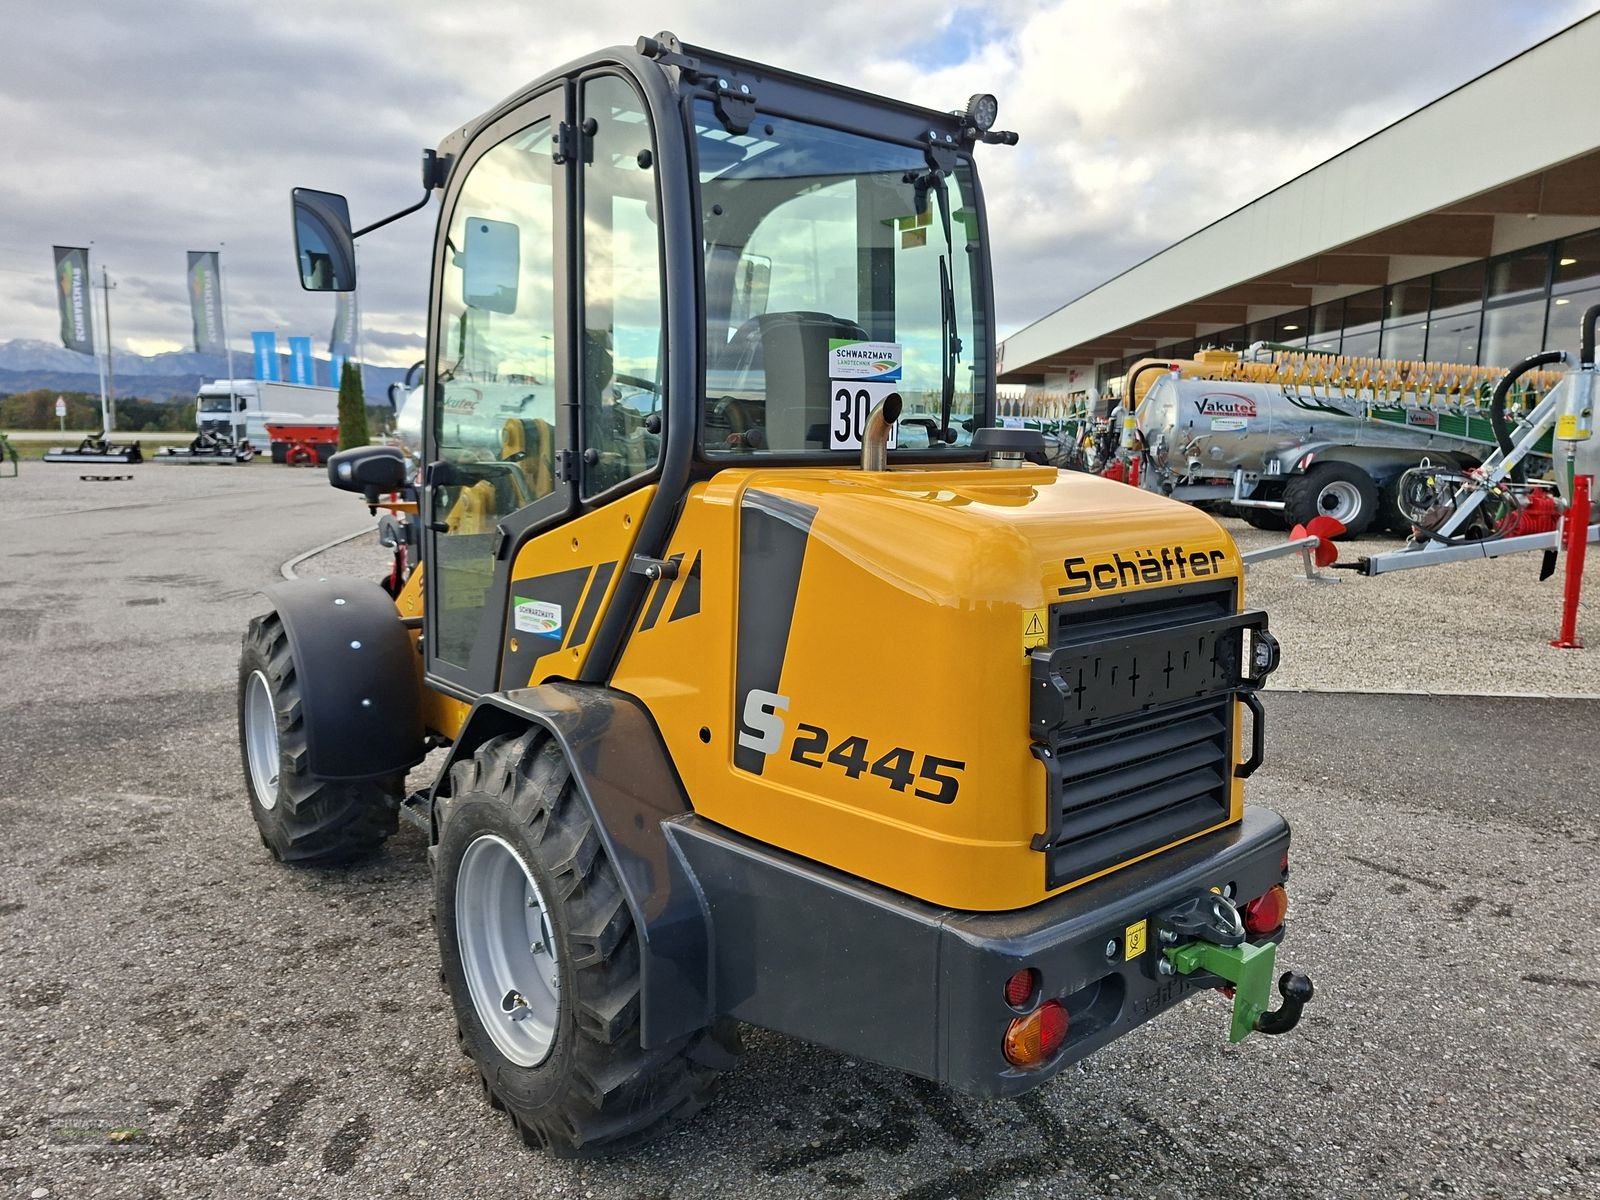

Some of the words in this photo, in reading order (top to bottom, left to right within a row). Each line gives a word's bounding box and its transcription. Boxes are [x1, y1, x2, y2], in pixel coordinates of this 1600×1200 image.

[836, 349, 893, 360] SCHWARZMAYR
[1194, 398, 1257, 415] Vakutec
[1057, 546, 1225, 596] Schäffer
[738, 689, 790, 755] S
[789, 723, 966, 805] 2445
